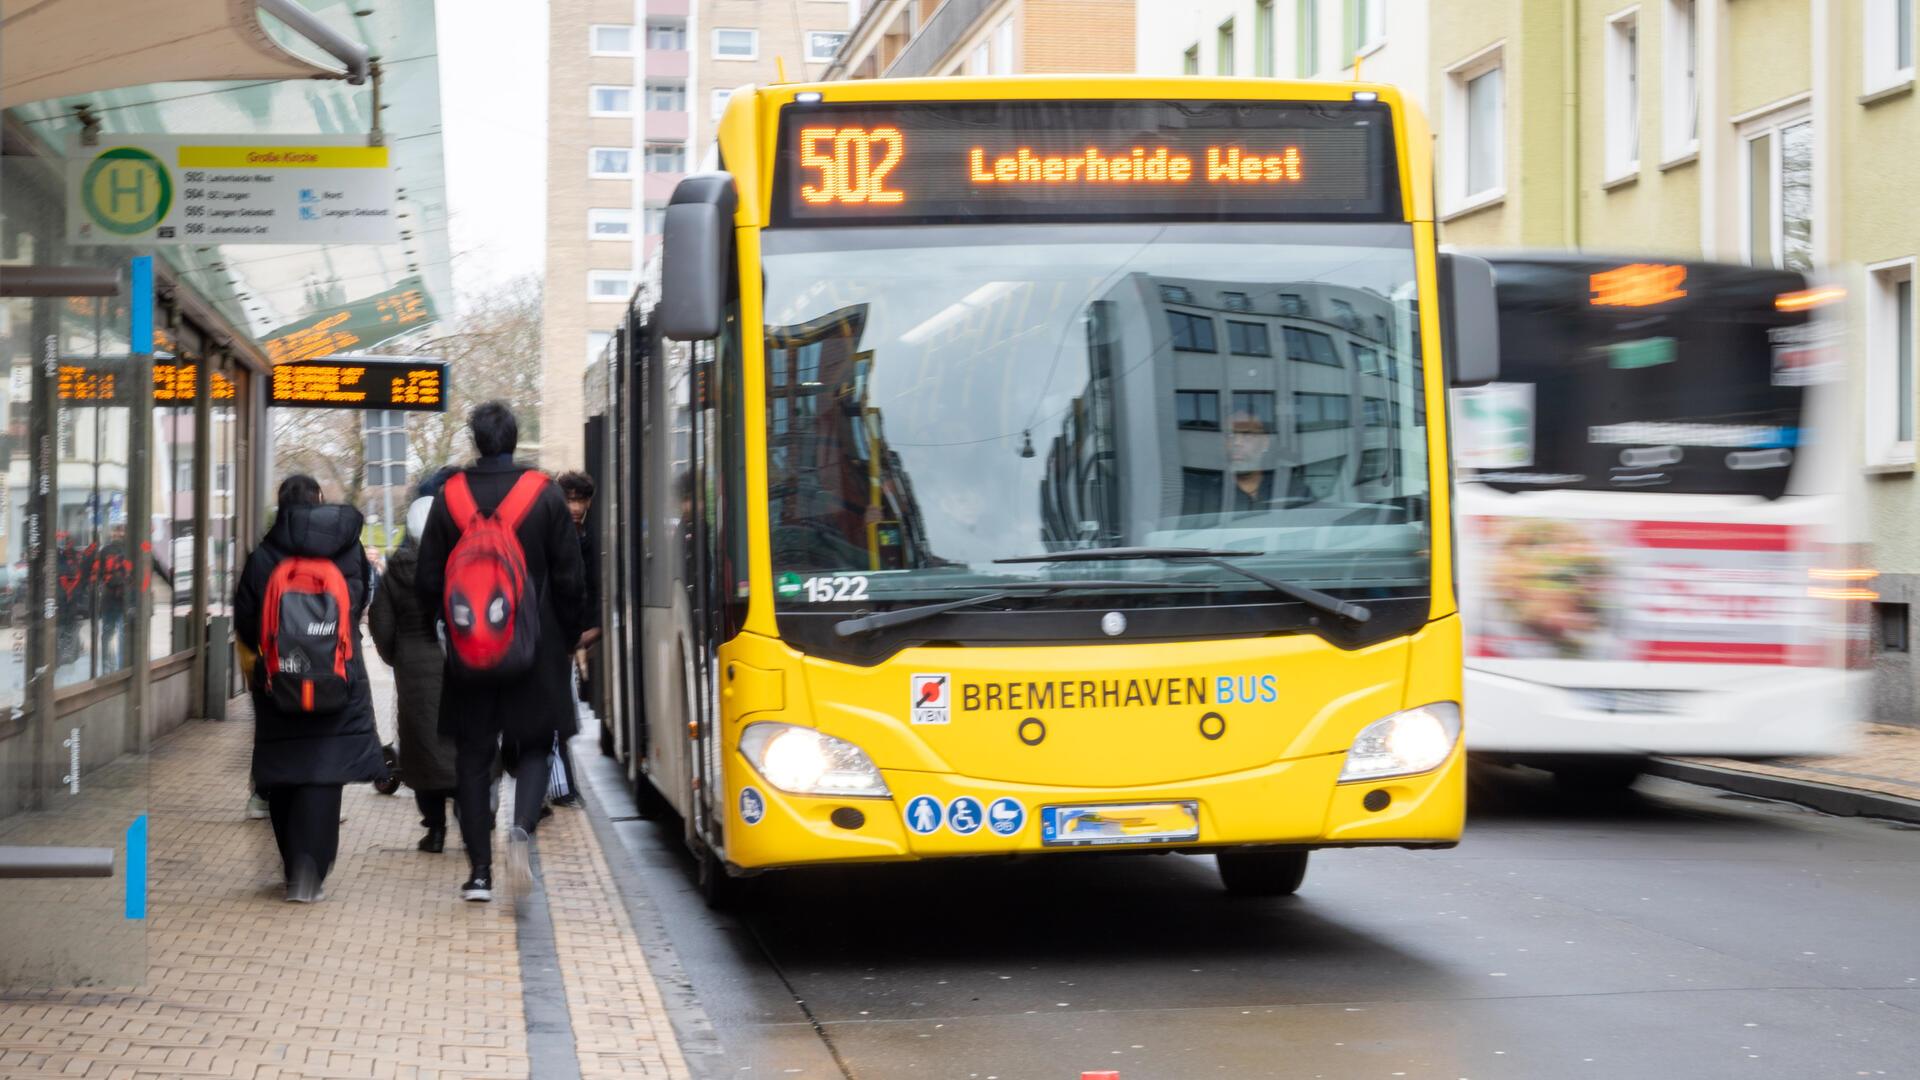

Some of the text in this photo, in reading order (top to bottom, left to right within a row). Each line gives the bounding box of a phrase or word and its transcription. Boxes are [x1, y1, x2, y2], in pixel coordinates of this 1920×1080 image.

[799, 126, 905, 206] 502
[969, 146, 1302, 184] Leherheide West
[111, 168, 144, 213] H
[803, 575, 870, 603] 1522
[914, 710, 946, 722] VBN
